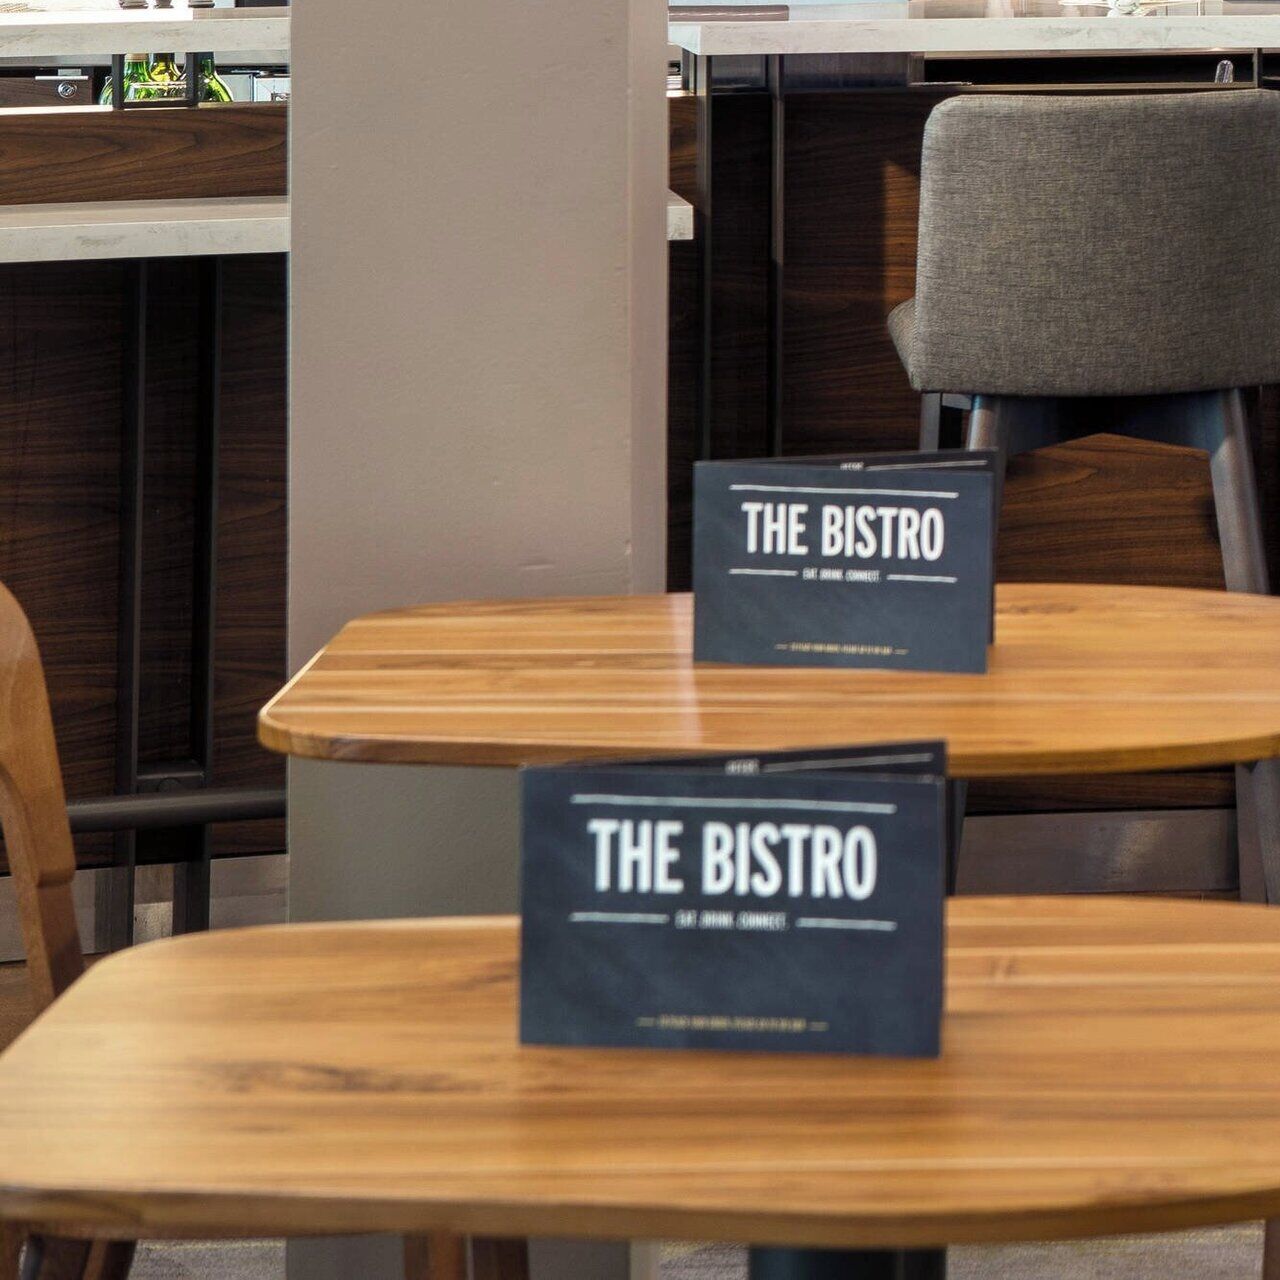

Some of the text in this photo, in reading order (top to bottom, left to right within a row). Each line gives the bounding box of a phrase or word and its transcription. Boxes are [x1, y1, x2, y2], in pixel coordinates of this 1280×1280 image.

[741, 502, 945, 561] THE BISTRO
[588, 819, 878, 901] THE BISTRO
